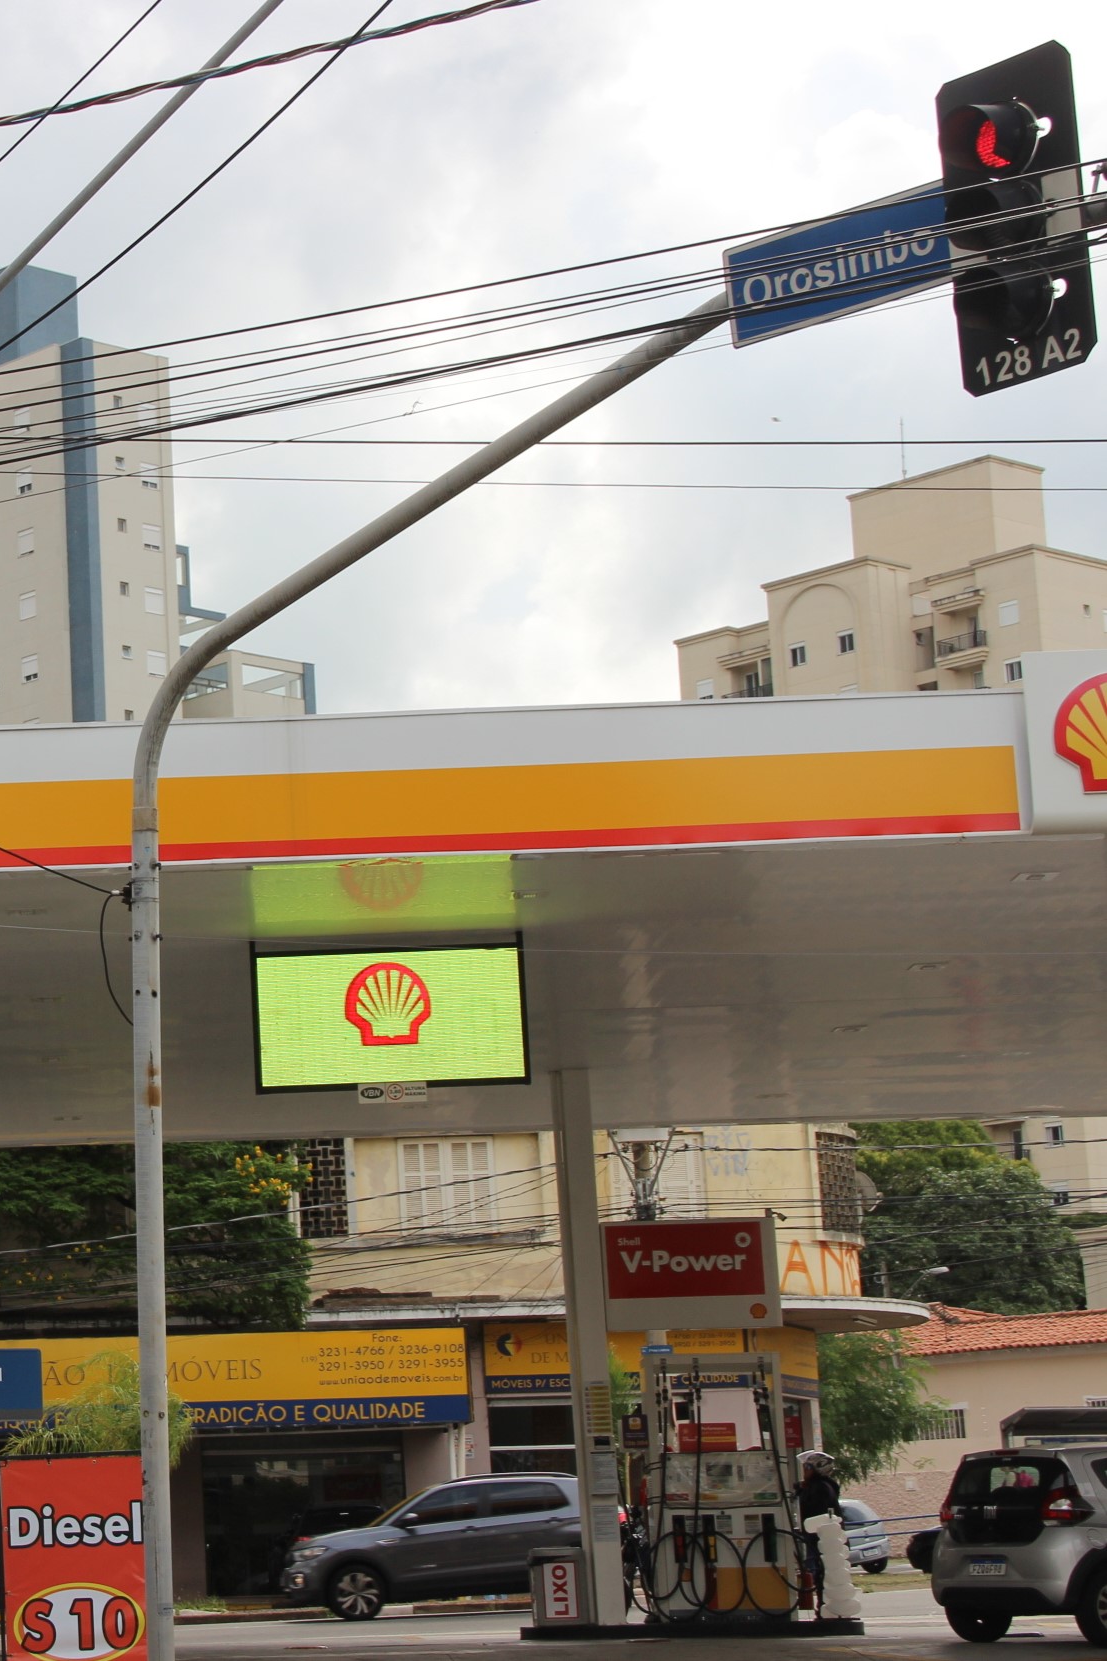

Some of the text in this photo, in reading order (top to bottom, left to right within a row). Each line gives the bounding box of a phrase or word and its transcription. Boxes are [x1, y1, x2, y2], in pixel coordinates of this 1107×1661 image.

[743, 229, 935, 308] Orosimbo
[976, 327, 1083, 386] 128 A2
[363, 1089, 381, 1097] VBN
[617, 1237, 641, 1246] Shell
[620, 1251, 748, 1273] V-Power
[372, 1333, 402, 1343] Fone:
[318, 1346, 385, 1357] 3231-4766
[398, 1343, 465, 1354] 3236-9108
[318, 1361, 385, 1371] 3291-3950
[398, 1358, 465, 1369] 3291-3955
[531, 1352, 550, 1364] DE
[318, 1374, 463, 1386] www.uniaodemoveis.com.br
[491, 1378, 532, 1389] MÓVEIS
[535, 1379, 546, 1388] P/
[183, 1402, 425, 1425] TRADIÇÃO E QUALIDADE
[8, 1499, 144, 1548] Diesel
[551, 1564, 569, 1616] LIXO
